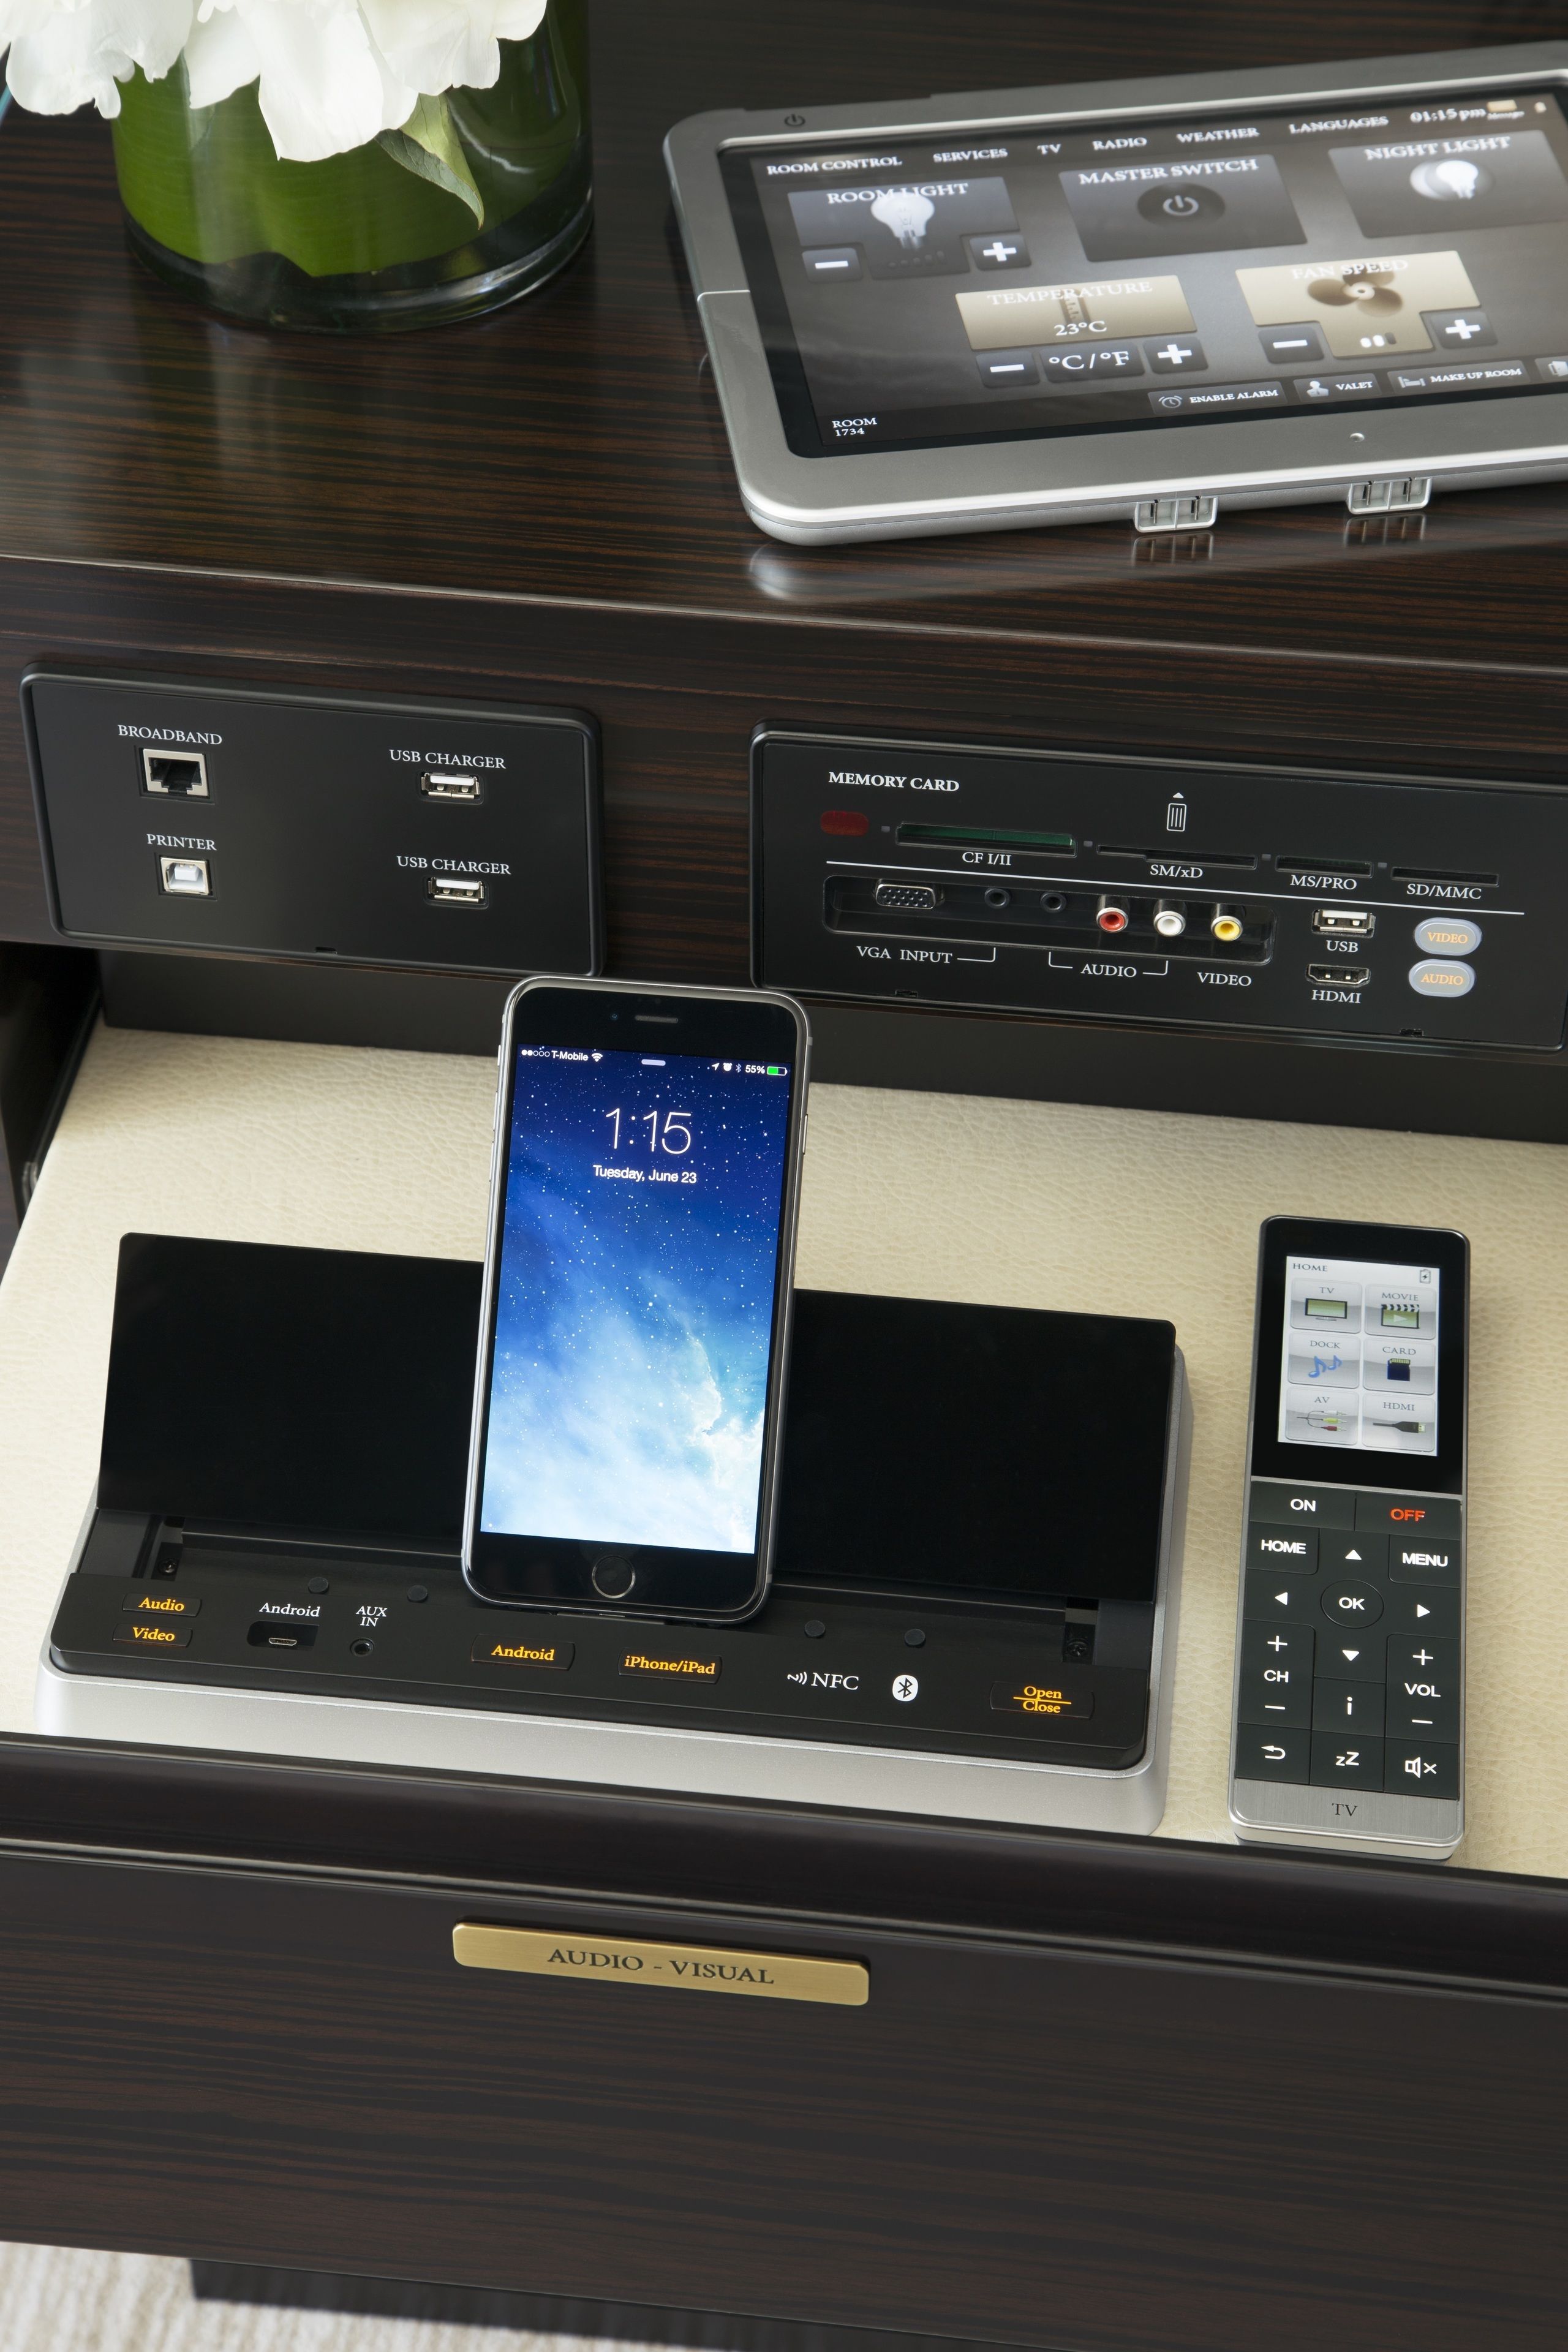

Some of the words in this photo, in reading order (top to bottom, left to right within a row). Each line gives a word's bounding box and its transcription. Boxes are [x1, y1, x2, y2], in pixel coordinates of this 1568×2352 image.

[1410, 108, 1457, 123] 01:15
[1459, 108, 1486, 121] pm
[1289, 116, 1389, 134] LANGUAGES
[1177, 127, 1259, 143] WEATHER
[1037, 143, 1061, 155] TV
[1093, 137, 1147, 151] RADIO
[1363, 143, 1438, 160] NIGHT
[1442, 136, 1510, 153] LIGHT
[932, 148, 1008, 163] SERVICES
[767, 162, 818, 175] ROOM
[821, 156, 902, 171] CONTROL
[1079, 164, 1167, 185] MASTER
[1171, 159, 1259, 178] SWITCH
[826, 188, 895, 205] ROOM
[895, 183, 968, 199] LIGHT
[1292, 265, 1335, 280] FAN
[1342, 259, 1409, 276] SPEED
[987, 282, 1152, 306] TEMPERATURE
[1054, 321, 1107, 336] 23°C
[1430, 374, 1466, 383] MAKE
[1466, 372, 1483, 380] UP
[1485, 368, 1522, 379] ROOM
[1336, 381, 1373, 391] VALET
[1189, 392, 1235, 404] ENABLE
[1236, 388, 1278, 401] ALARM
[832, 417, 877, 428] ROOM
[835, 427, 865, 437] 1734
[118, 725, 222, 745] BROADBAND
[389, 749, 421, 762] USB
[425, 752, 506, 769] CHARGER
[828, 771, 907, 788] MEMORY
[910, 778, 960, 792] CARD
[147, 834, 217, 851] PRINTER
[396, 856, 428, 868] USB
[432, 859, 511, 875] CHARGER
[962, 851, 984, 864] CF
[987, 854, 1011, 865] I/II
[1150, 864, 1203, 878] SM/xD
[1290, 874, 1357, 891] MS/PRO
[1406, 883, 1482, 900] SD/MMC
[1427, 932, 1468, 944] VIDEO
[1326, 940, 1359, 952] USB
[856, 946, 891, 959] VGA
[900, 949, 953, 963] INPUT
[1080, 963, 1137, 978] AUDIO
[1197, 971, 1252, 987] VIDEO
[1420, 973, 1464, 986] AUDIO
[1311, 989, 1362, 1004] HDMI
[551, 1050, 589, 1061] T-Mobile
[745, 1064, 766, 1074] 55%
[606, 1107, 692, 1155] 1:15
[593, 1164, 645, 1182] Tuesday,
[649, 1169, 679, 1183] June
[681, 1172, 697, 1183] 23
[1292, 1262, 1328, 1272] HOME
[1381, 1292, 1419, 1301] MOVIE
[1310, 1340, 1341, 1349] DOCK
[1382, 1346, 1416, 1355] CARD
[1383, 1402, 1415, 1411] HDMI
[1290, 1498, 1316, 1512] ON
[1390, 1508, 1425, 1522] OFF
[1261, 1539, 1306, 1555] HOME
[1402, 1553, 1448, 1567] MENU
[138, 1597, 184, 1612] Audio
[259, 1602, 320, 1618] Android
[1339, 1597, 1365, 1610] OK
[356, 1605, 387, 1618] AUX
[360, 1616, 379, 1627] IN
[132, 1627, 175, 1642] Video
[491, 1645, 556, 1661] Android
[624, 1656, 716, 1675] iPhone/iPad
[811, 1672, 859, 1691] NFC
[1264, 1670, 1289, 1683] CH
[1023, 1686, 1062, 1700] Open
[1404, 1683, 1441, 1697] VOL
[1023, 1701, 1061, 1714] Close
[1332, 1803, 1358, 1817] TV
[547, 1949, 644, 1971] AUDIO
[669, 1960, 775, 1985] VISUAL
